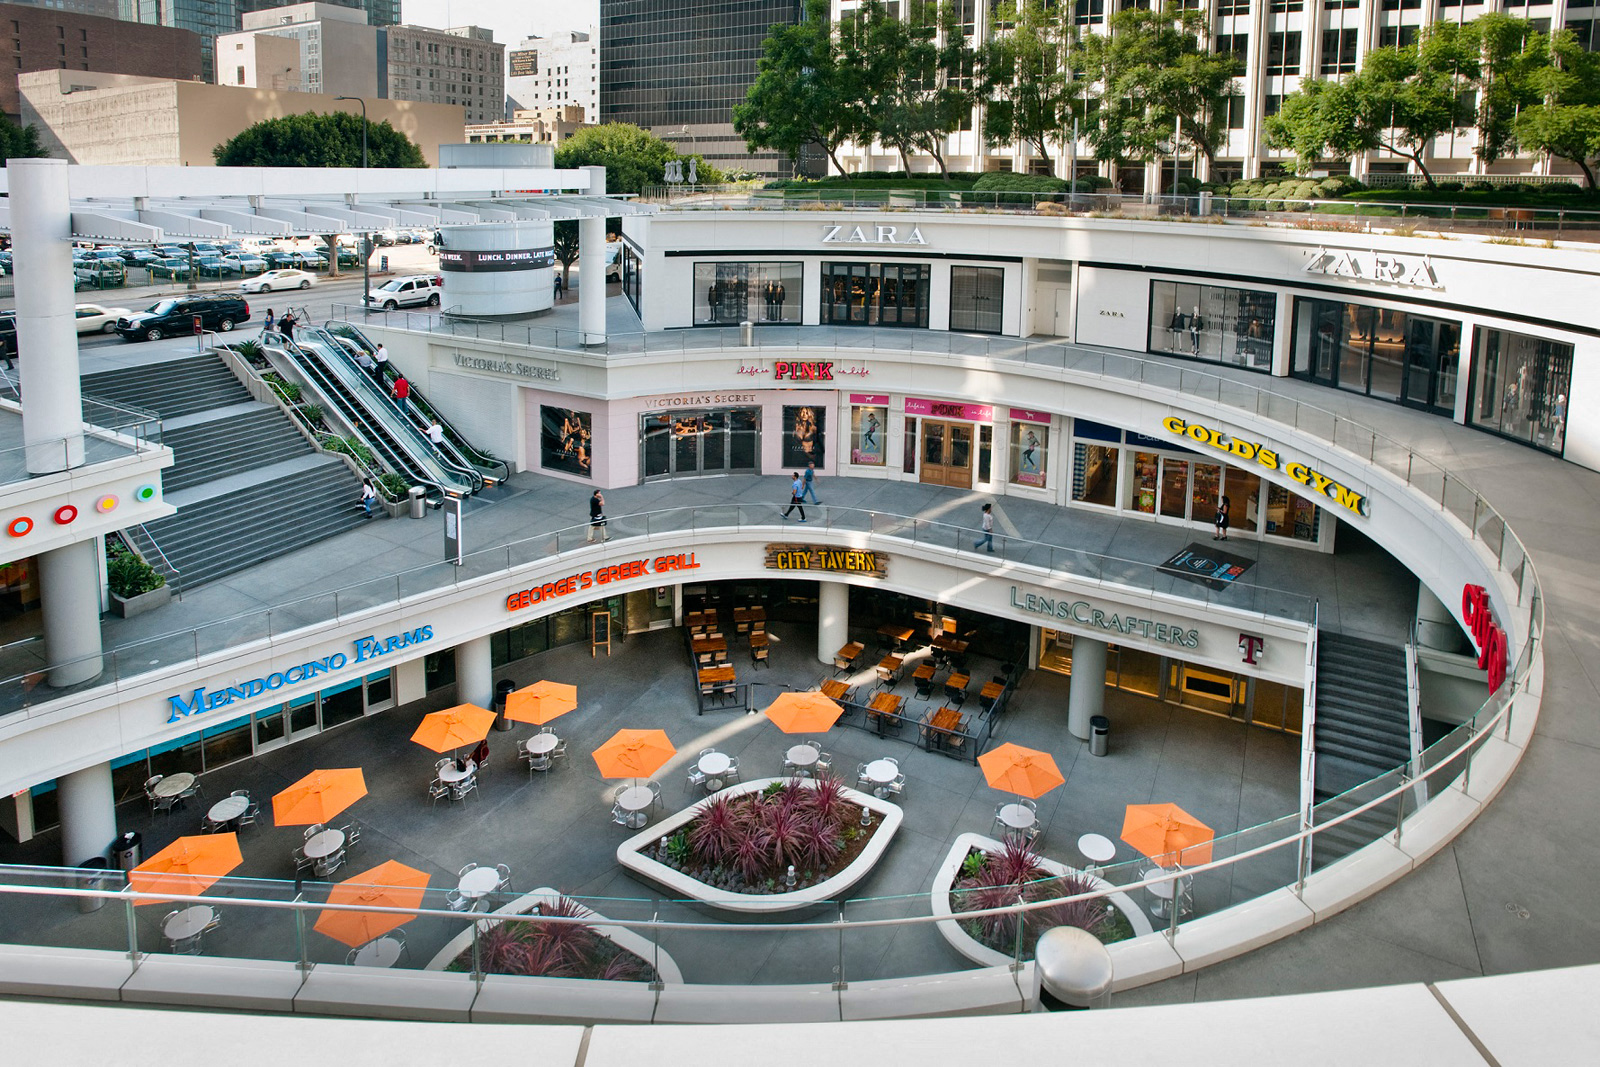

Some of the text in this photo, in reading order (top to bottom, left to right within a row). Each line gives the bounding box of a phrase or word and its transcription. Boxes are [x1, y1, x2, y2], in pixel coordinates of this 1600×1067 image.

[822, 225, 930, 245] ZARA
[478, 254, 504, 262] LUNCH.
[505, 251, 532, 260] DINNER.
[1301, 249, 1444, 291] ZARA
[1099, 309, 1125, 319] ZARA
[452, 353, 560, 381] VICTORIA'S SECRET
[737, 365, 759, 376] life
[775, 361, 834, 380] PINK
[847, 366, 870, 377] life
[644, 394, 756, 408] VICTORIA'S SECRET
[1162, 416, 1367, 516] GOLD'S GYM
[777, 551, 876, 571] CITY TAVERN
[506, 552, 700, 612] GEORGE'S GREEK GRILL
[1010, 585, 1199, 650] LENSCRAFTERS
[167, 625, 434, 724] MENDOCINO FARMS
